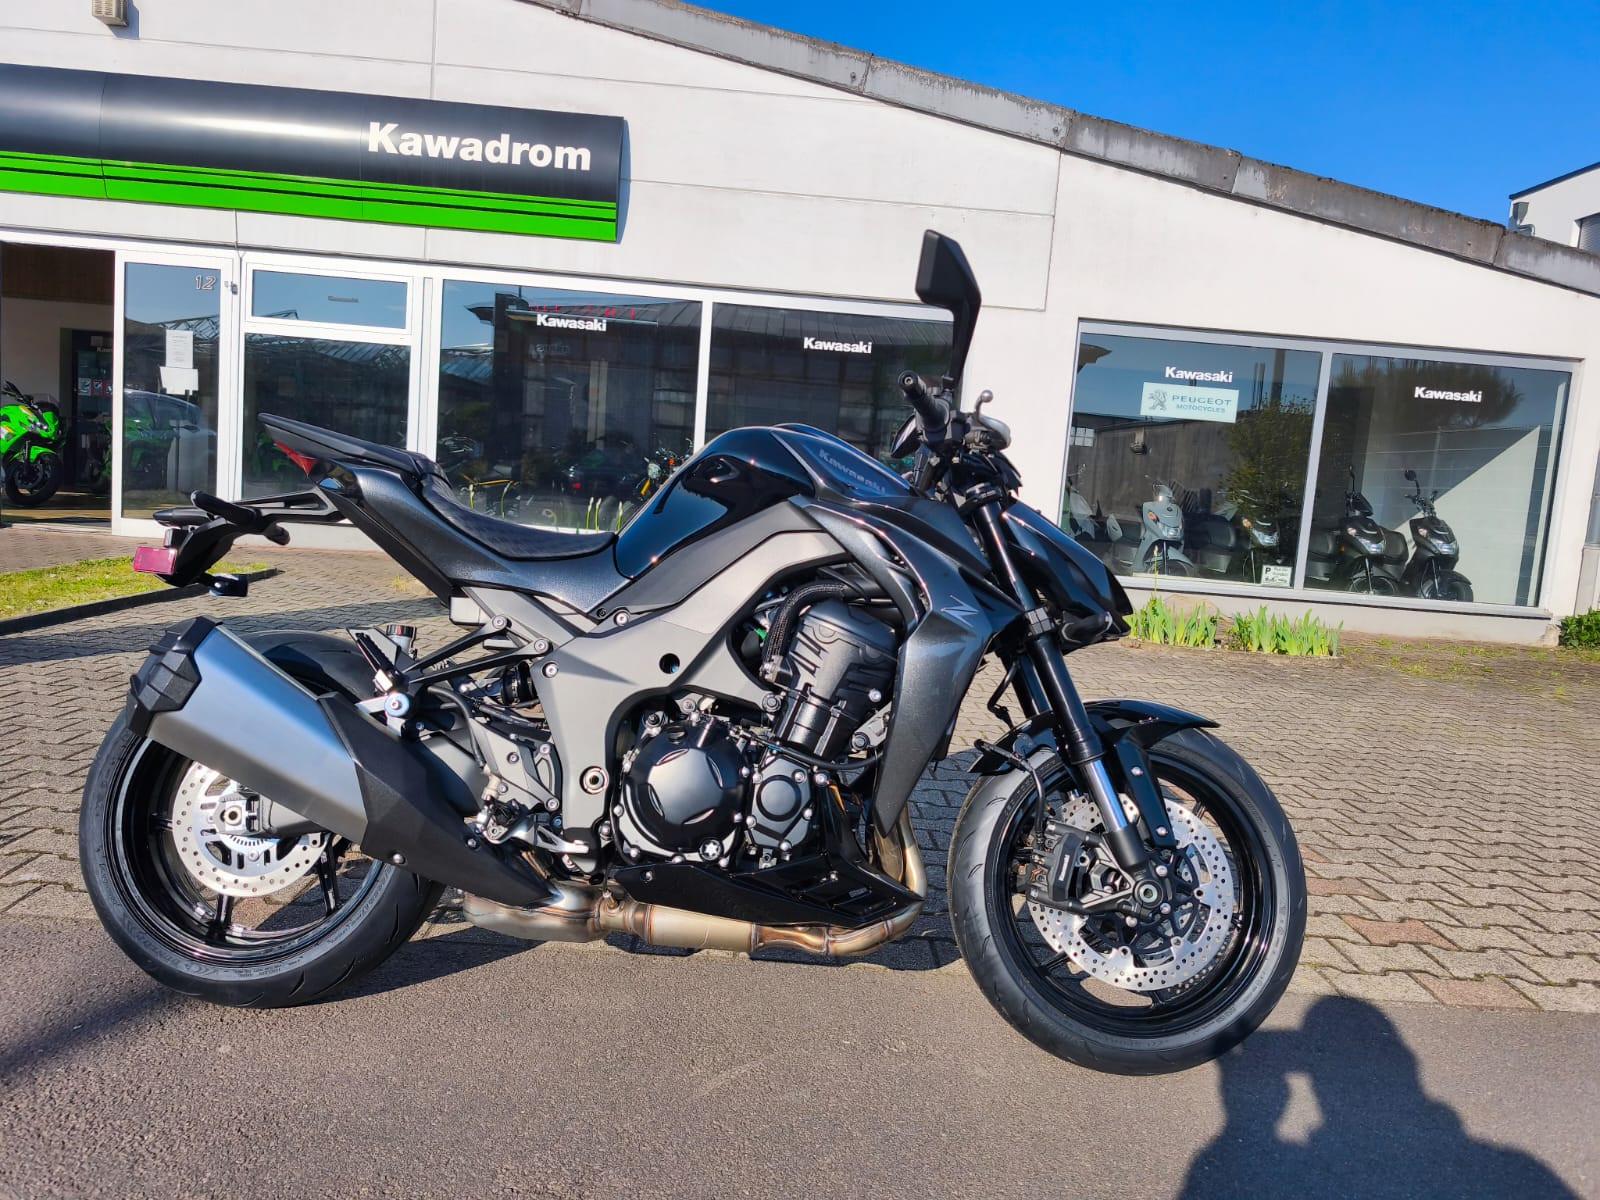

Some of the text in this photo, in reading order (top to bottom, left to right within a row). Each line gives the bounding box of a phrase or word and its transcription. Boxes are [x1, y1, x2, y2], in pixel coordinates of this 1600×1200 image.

[368, 121, 591, 171] Kawadrom
[195, 275, 216, 290] 12
[536, 313, 607, 332] Kawasaki
[803, 336, 873, 354] Kawasaki
[1164, 366, 1233, 383] Kawasaki
[1172, 394, 1232, 406] PEUGEOT
[1414, 386, 1483, 403] Kawasaki
[1175, 403, 1226, 414] MOTOCYCLES
[1265, 567, 1272, 575] P
